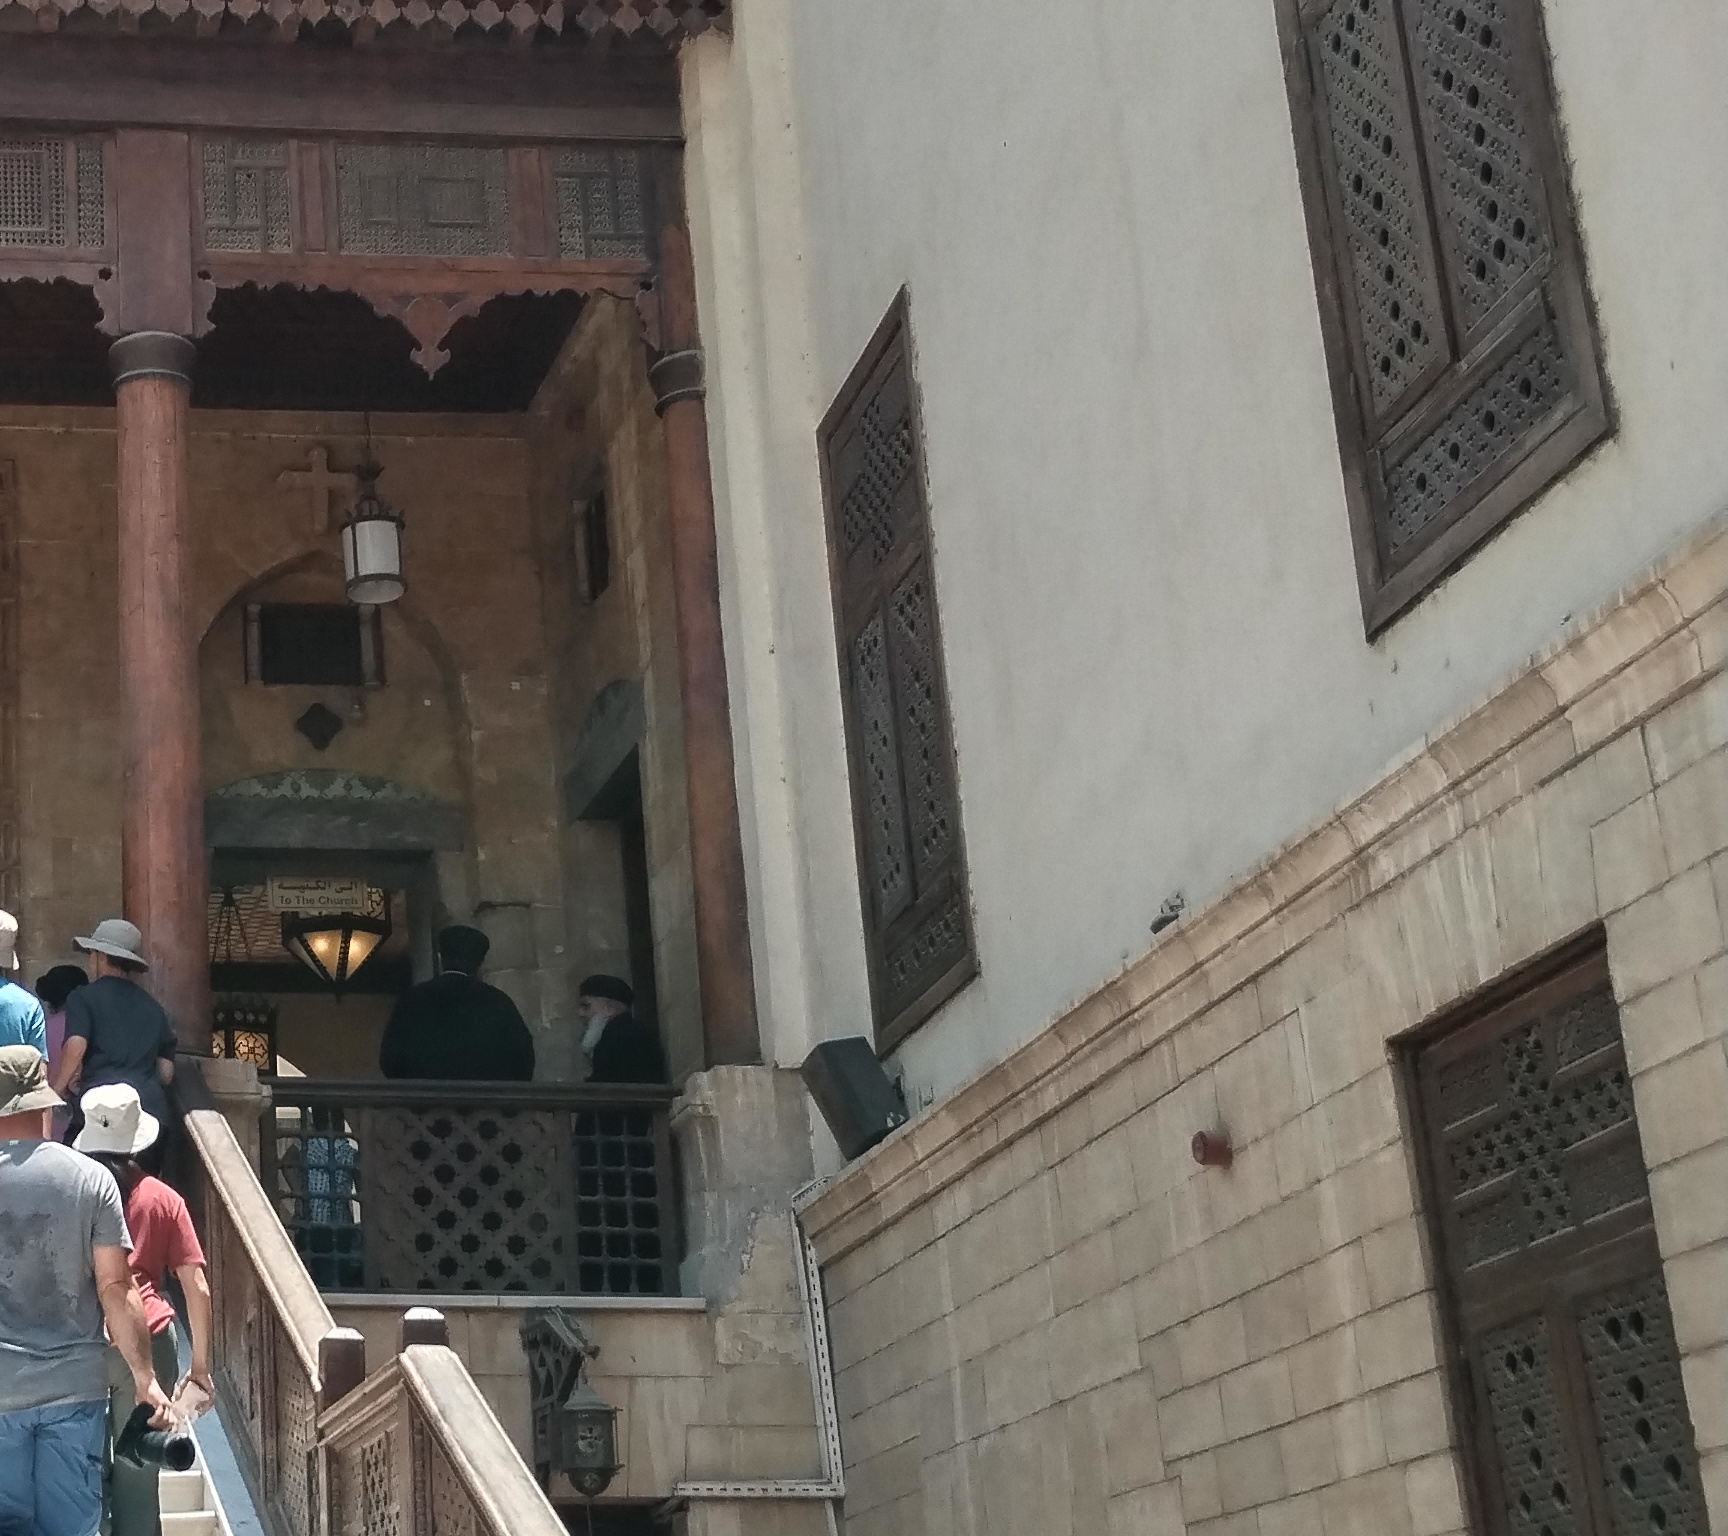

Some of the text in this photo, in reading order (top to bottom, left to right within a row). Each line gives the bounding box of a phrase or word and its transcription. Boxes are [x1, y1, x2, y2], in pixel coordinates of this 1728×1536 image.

[278, 895, 358, 905] To The Church
